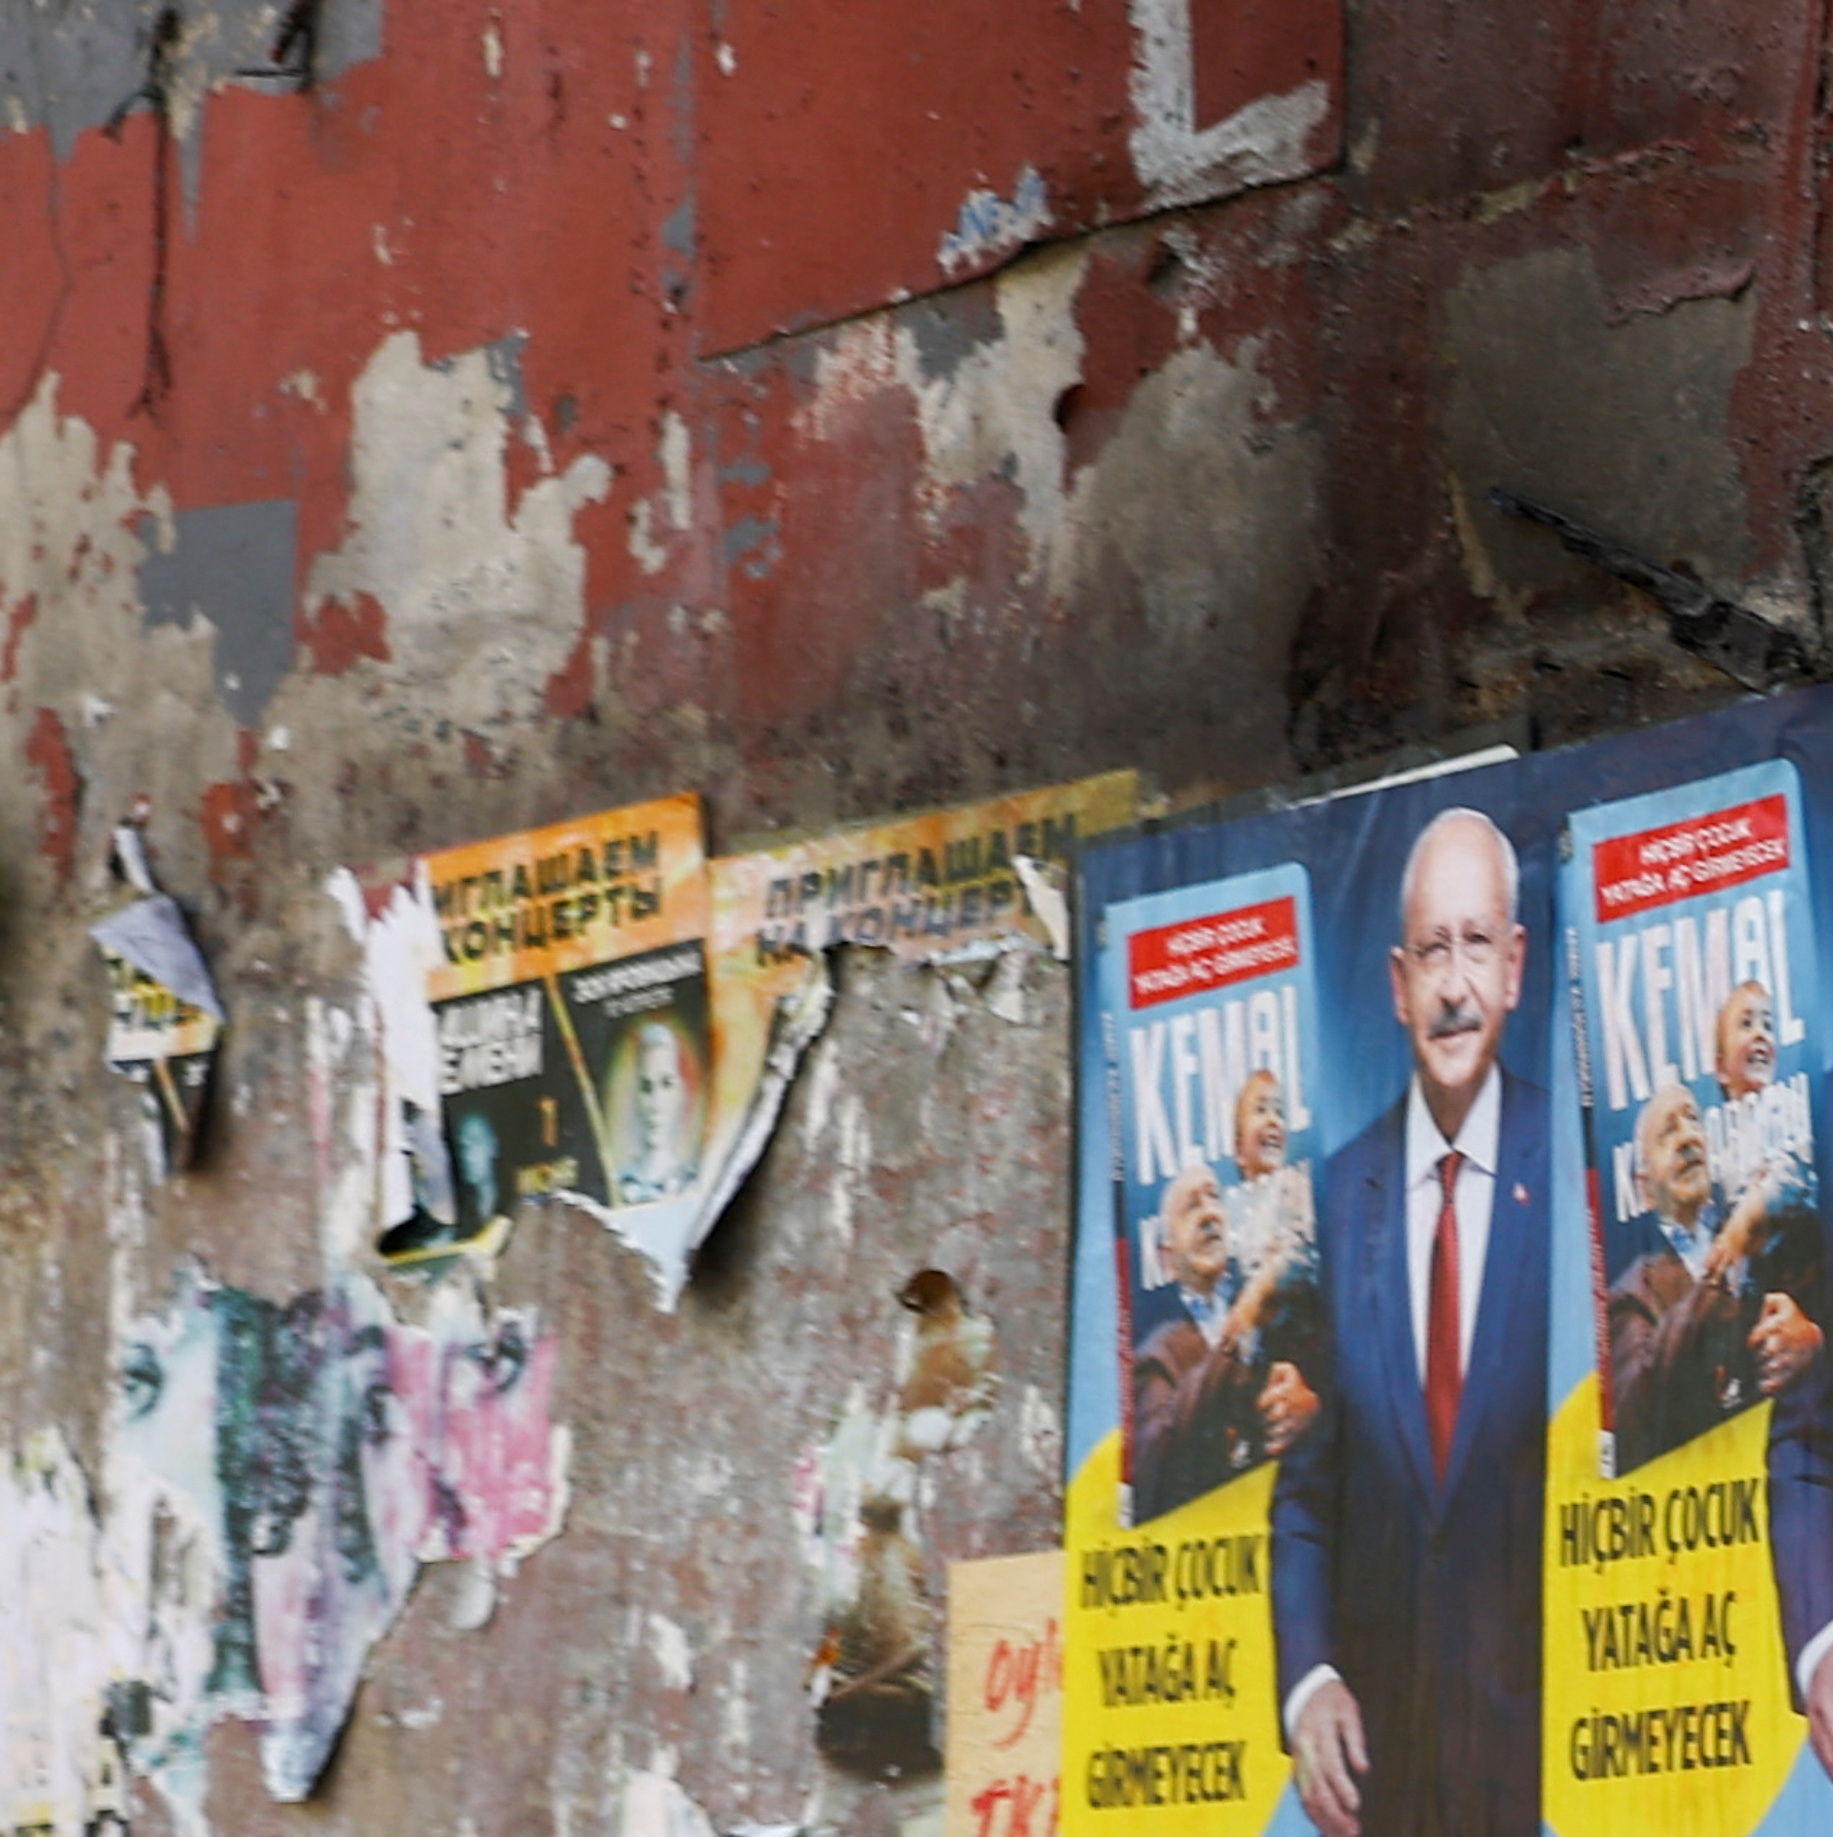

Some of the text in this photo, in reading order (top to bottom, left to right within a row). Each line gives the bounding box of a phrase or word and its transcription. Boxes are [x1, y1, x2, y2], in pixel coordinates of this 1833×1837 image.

[1561, 1478, 1759, 1574] HİÇBİR ÇOCUK
[1581, 1588, 1736, 1672] YATAĞA AÇ
[1570, 1700, 1752, 1781] GİRMEYECEK
